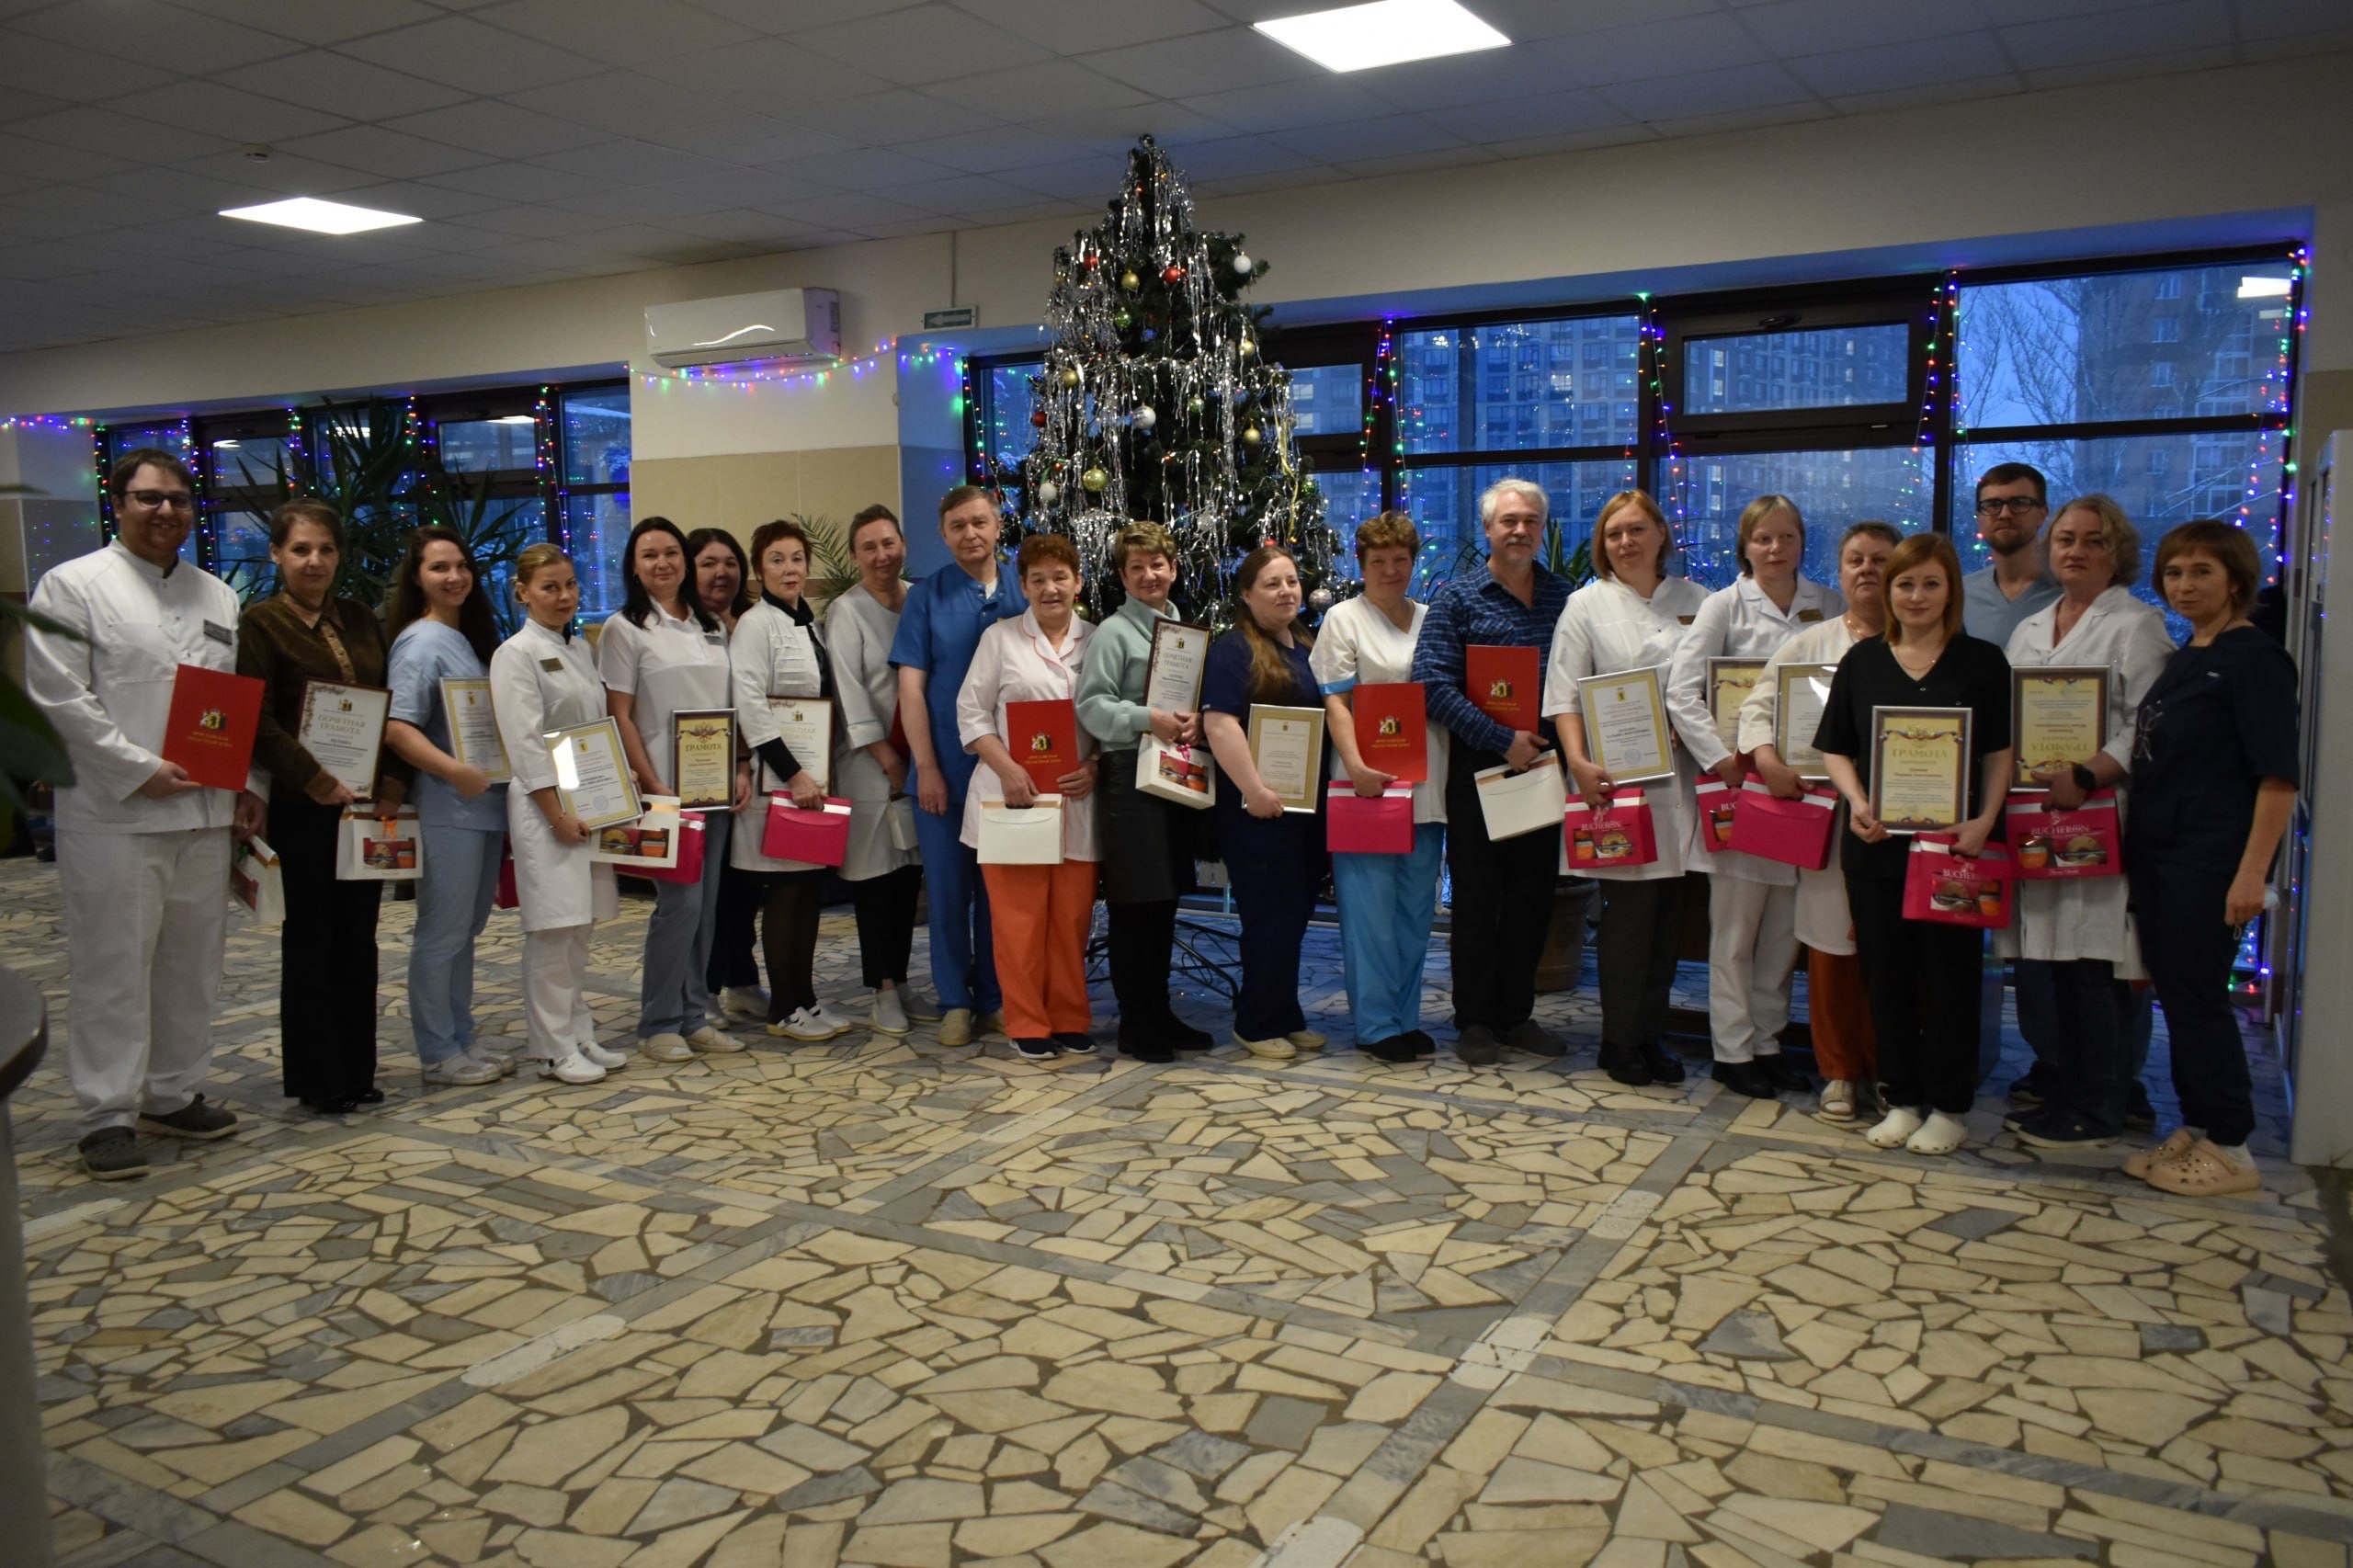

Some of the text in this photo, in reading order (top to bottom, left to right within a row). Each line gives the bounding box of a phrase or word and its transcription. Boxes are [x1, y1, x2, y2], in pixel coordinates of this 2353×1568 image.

[686, 743, 722, 752] ГРАМОТА
[2030, 743, 2087, 751] ГРАМОТА
[1893, 749, 1948, 758] ГРАМОТА
